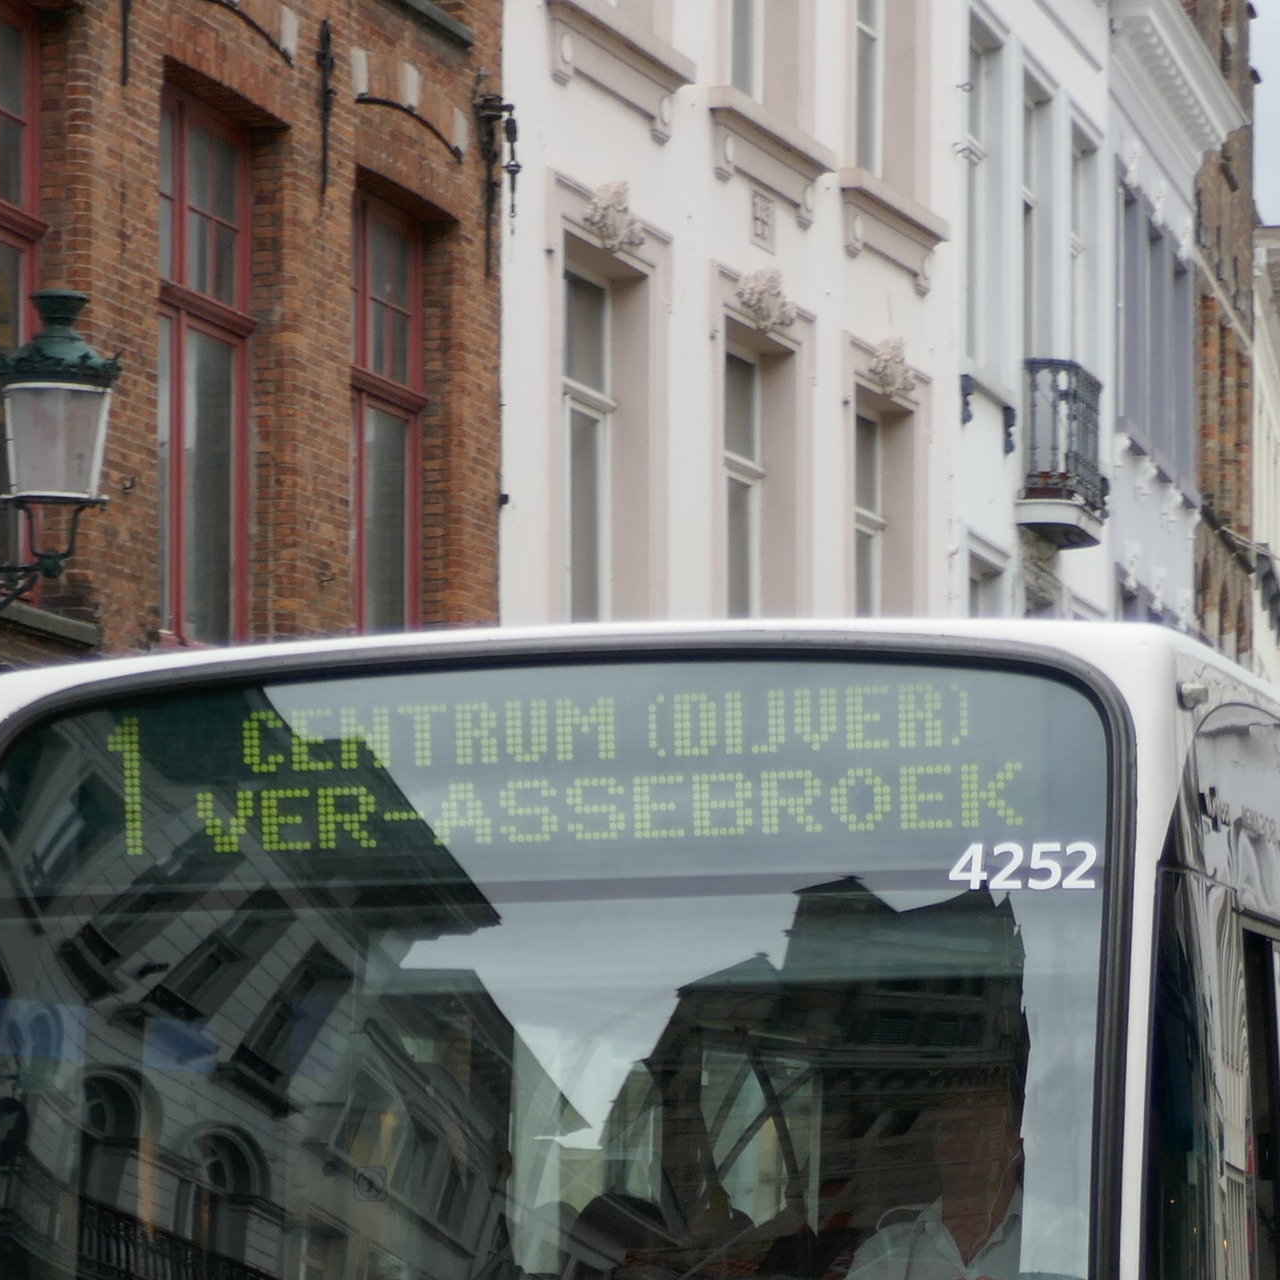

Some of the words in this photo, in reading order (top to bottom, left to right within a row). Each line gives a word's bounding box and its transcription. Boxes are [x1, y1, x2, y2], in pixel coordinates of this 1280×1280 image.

[242, 695, 616, 773] CENTRUM
[107, 716, 143, 856] 1
[196, 761, 1024, 853] VER-ASSEBROEK
[949, 843, 1097, 890] 4252
